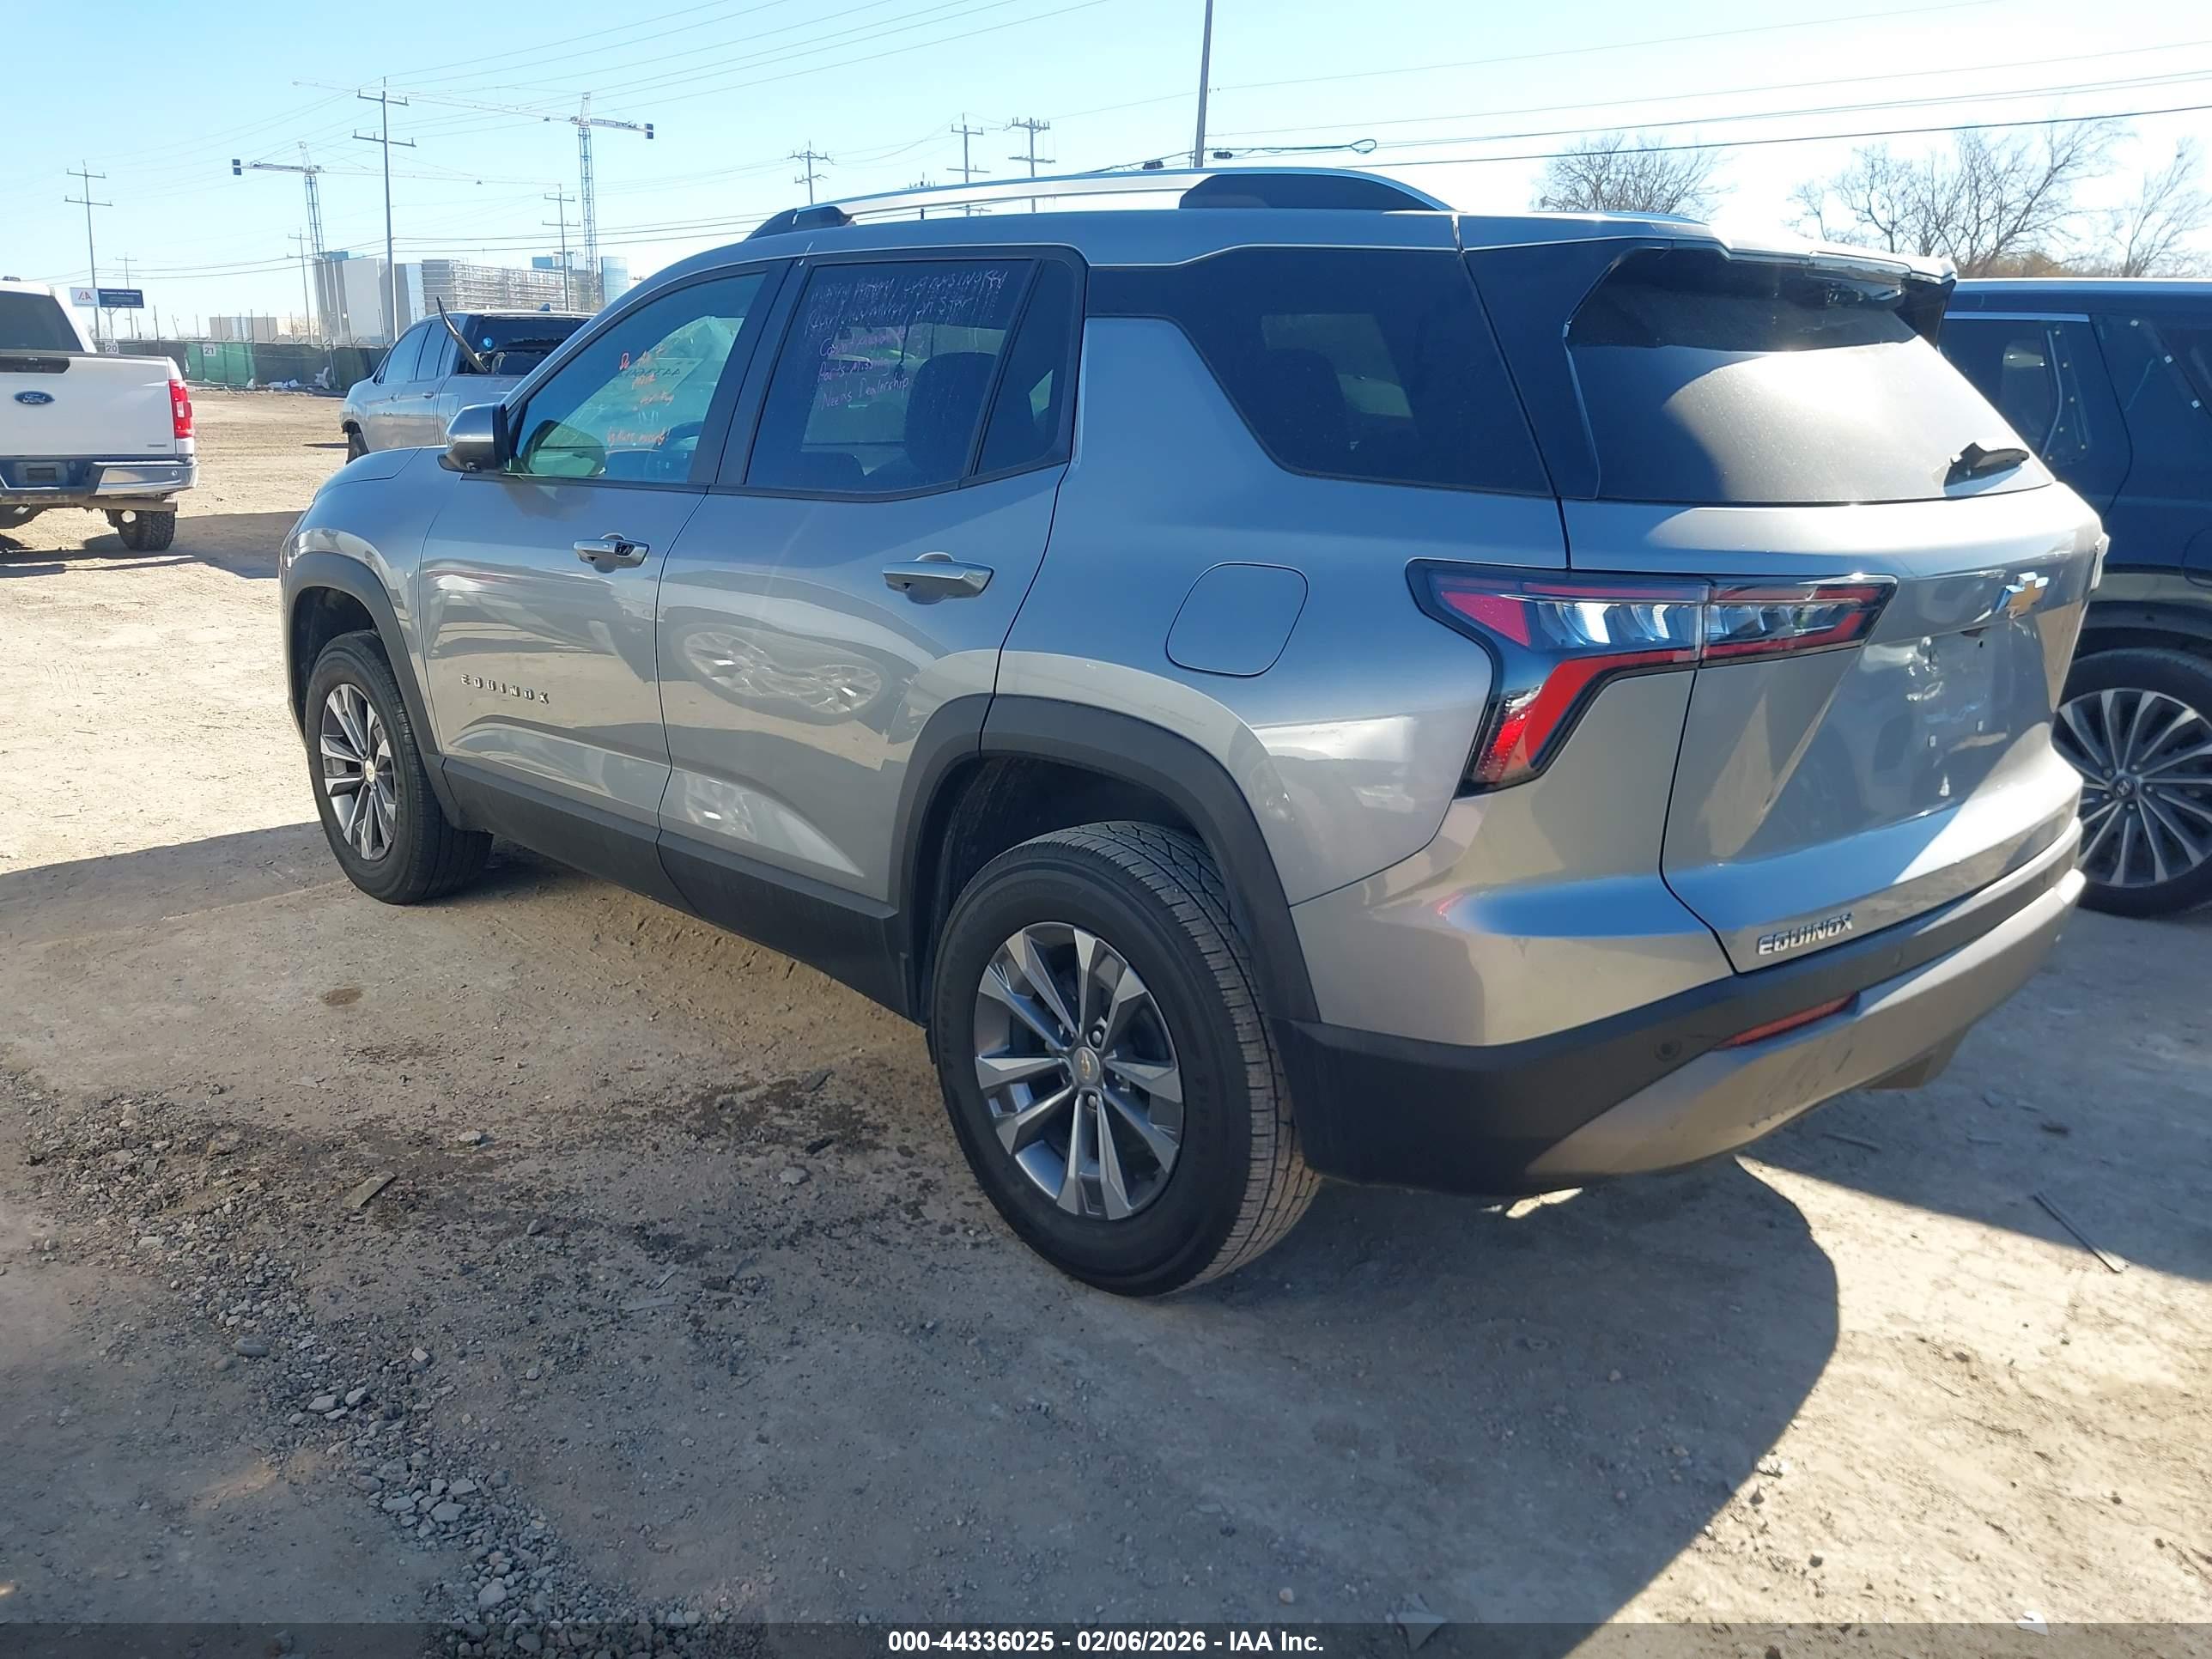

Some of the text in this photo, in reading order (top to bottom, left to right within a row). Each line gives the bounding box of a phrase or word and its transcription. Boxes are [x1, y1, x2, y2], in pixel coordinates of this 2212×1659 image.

[106, 344, 118, 353] 20
[22, 393, 46, 404] Ford
[460, 673, 550, 705] EQUINOX
[1757, 911, 1855, 956] EQUINOX
